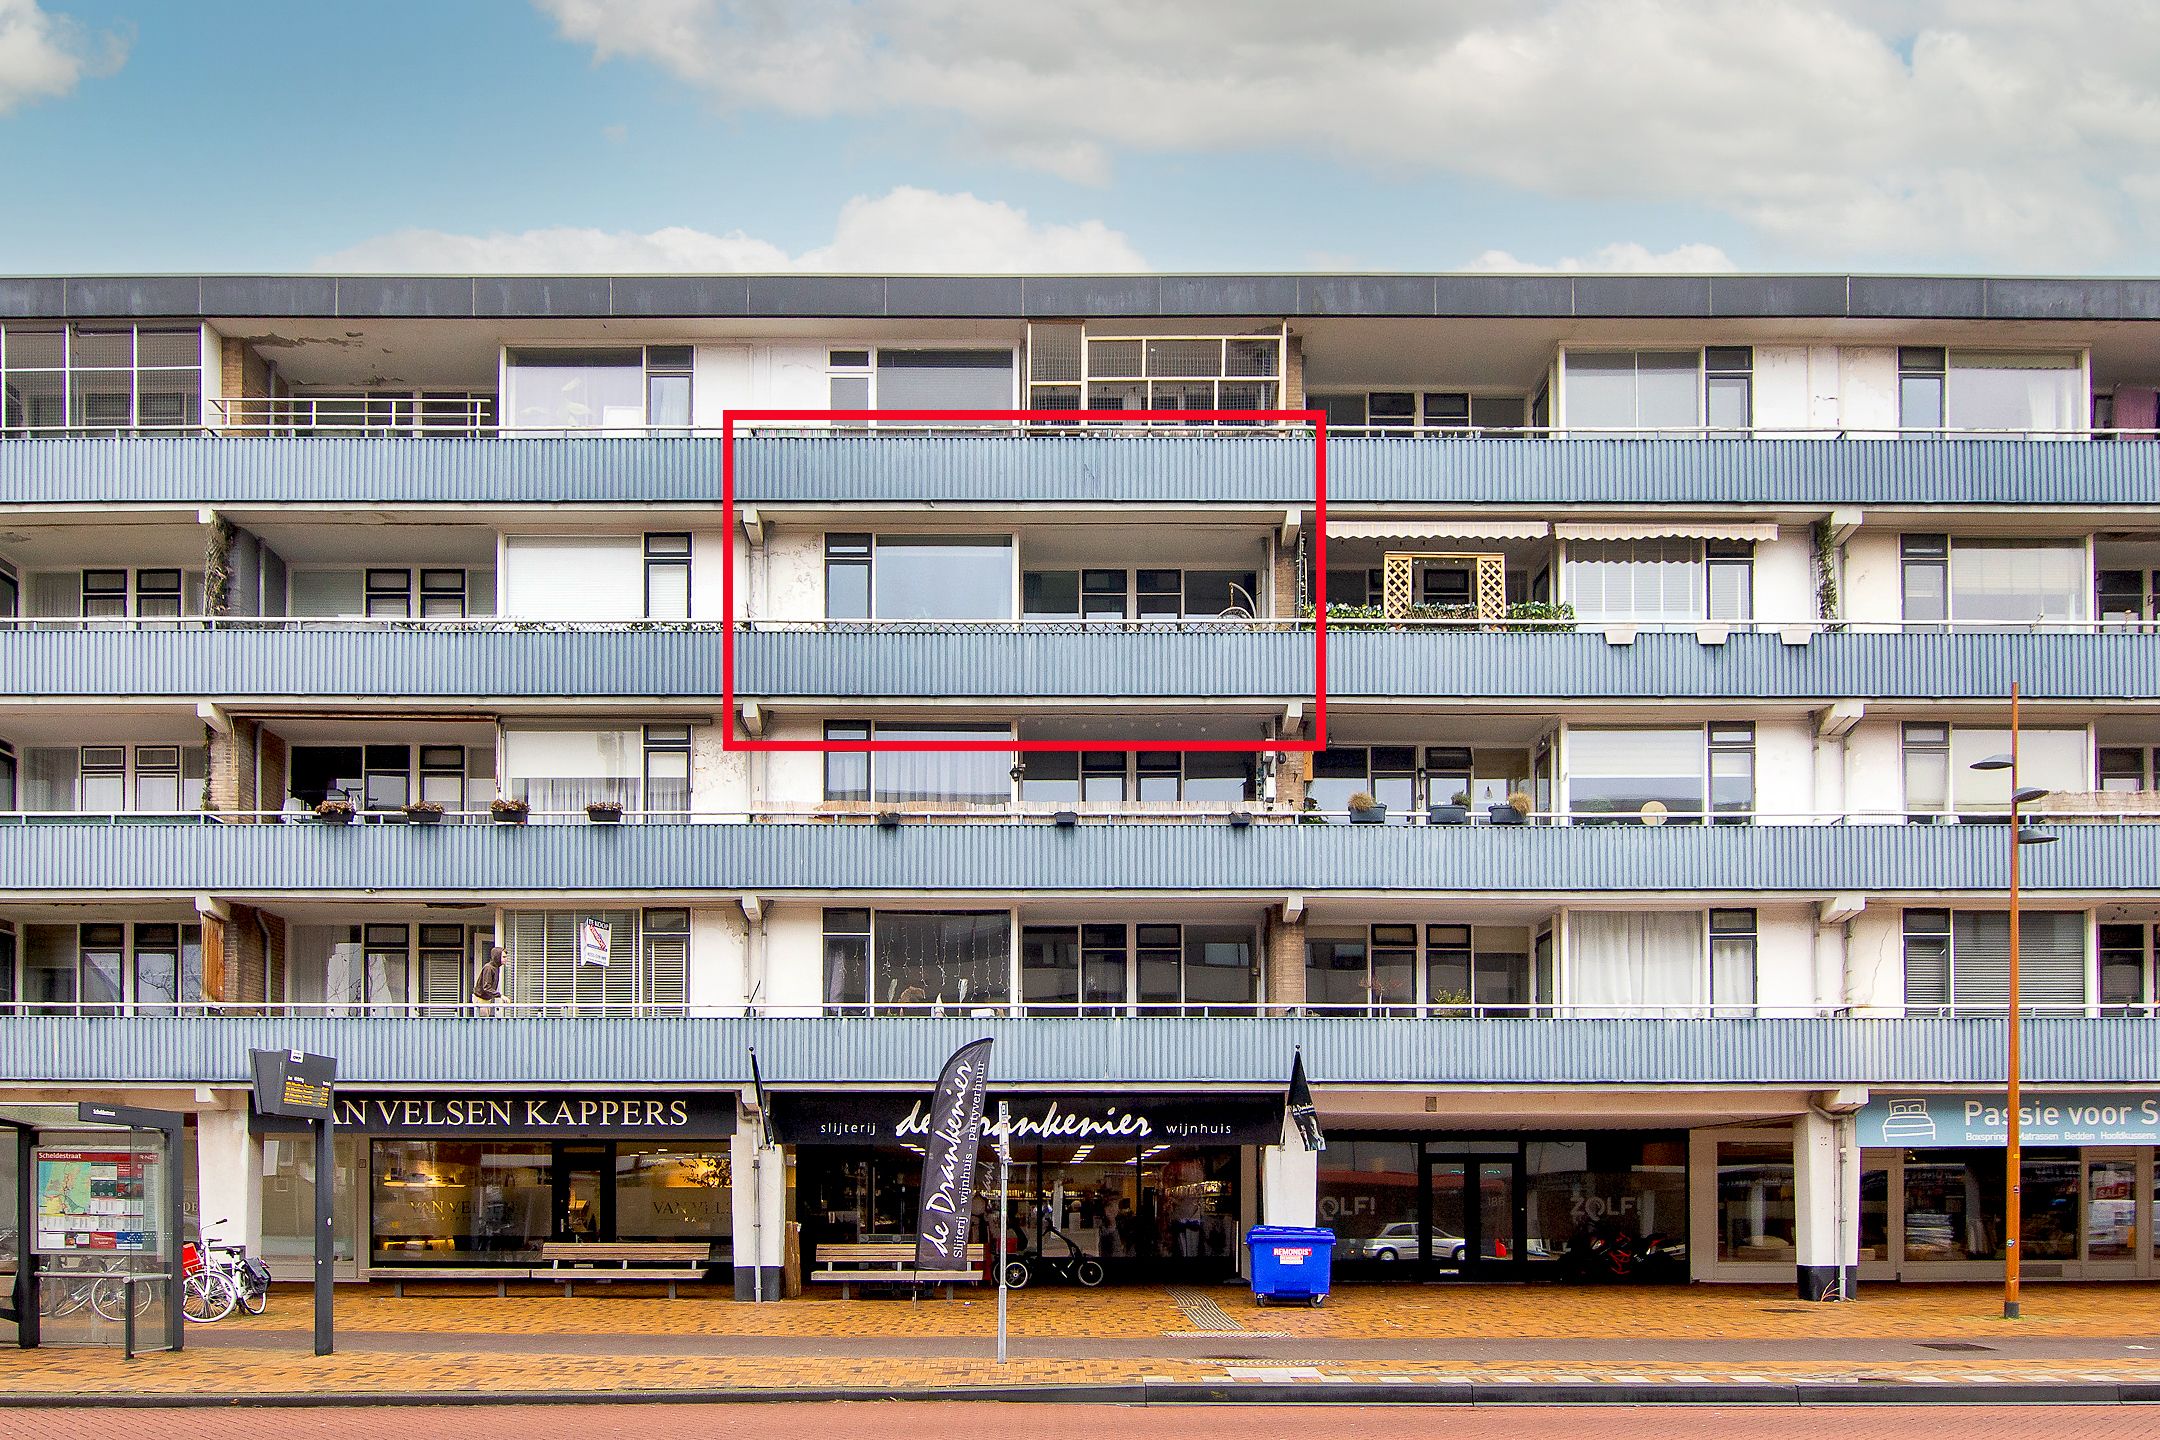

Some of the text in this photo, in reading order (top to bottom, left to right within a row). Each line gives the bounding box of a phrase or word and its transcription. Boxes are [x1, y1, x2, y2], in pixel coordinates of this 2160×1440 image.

[375, 1100, 513, 1126] VELSEN
[524, 1100, 688, 1126] KAPPERS
[820, 1122, 876, 1136] slijterij
[980, 1101, 1153, 1138] rankenier
[1166, 1123, 1232, 1137] wijnhuis
[968, 1061, 985, 1142] partyverhuur
[2068, 1106, 2132, 1126] voor
[1965, 1132, 2009, 1143] Boxspring
[2064, 1131, 2095, 1141] Bedden
[38, 1152, 82, 1160] Scheldestraat
[922, 1060, 972, 1258] de Drankenier
[959, 1153, 972, 1205] wijnhuis
[953, 1216, 968, 1258] Slijterij
